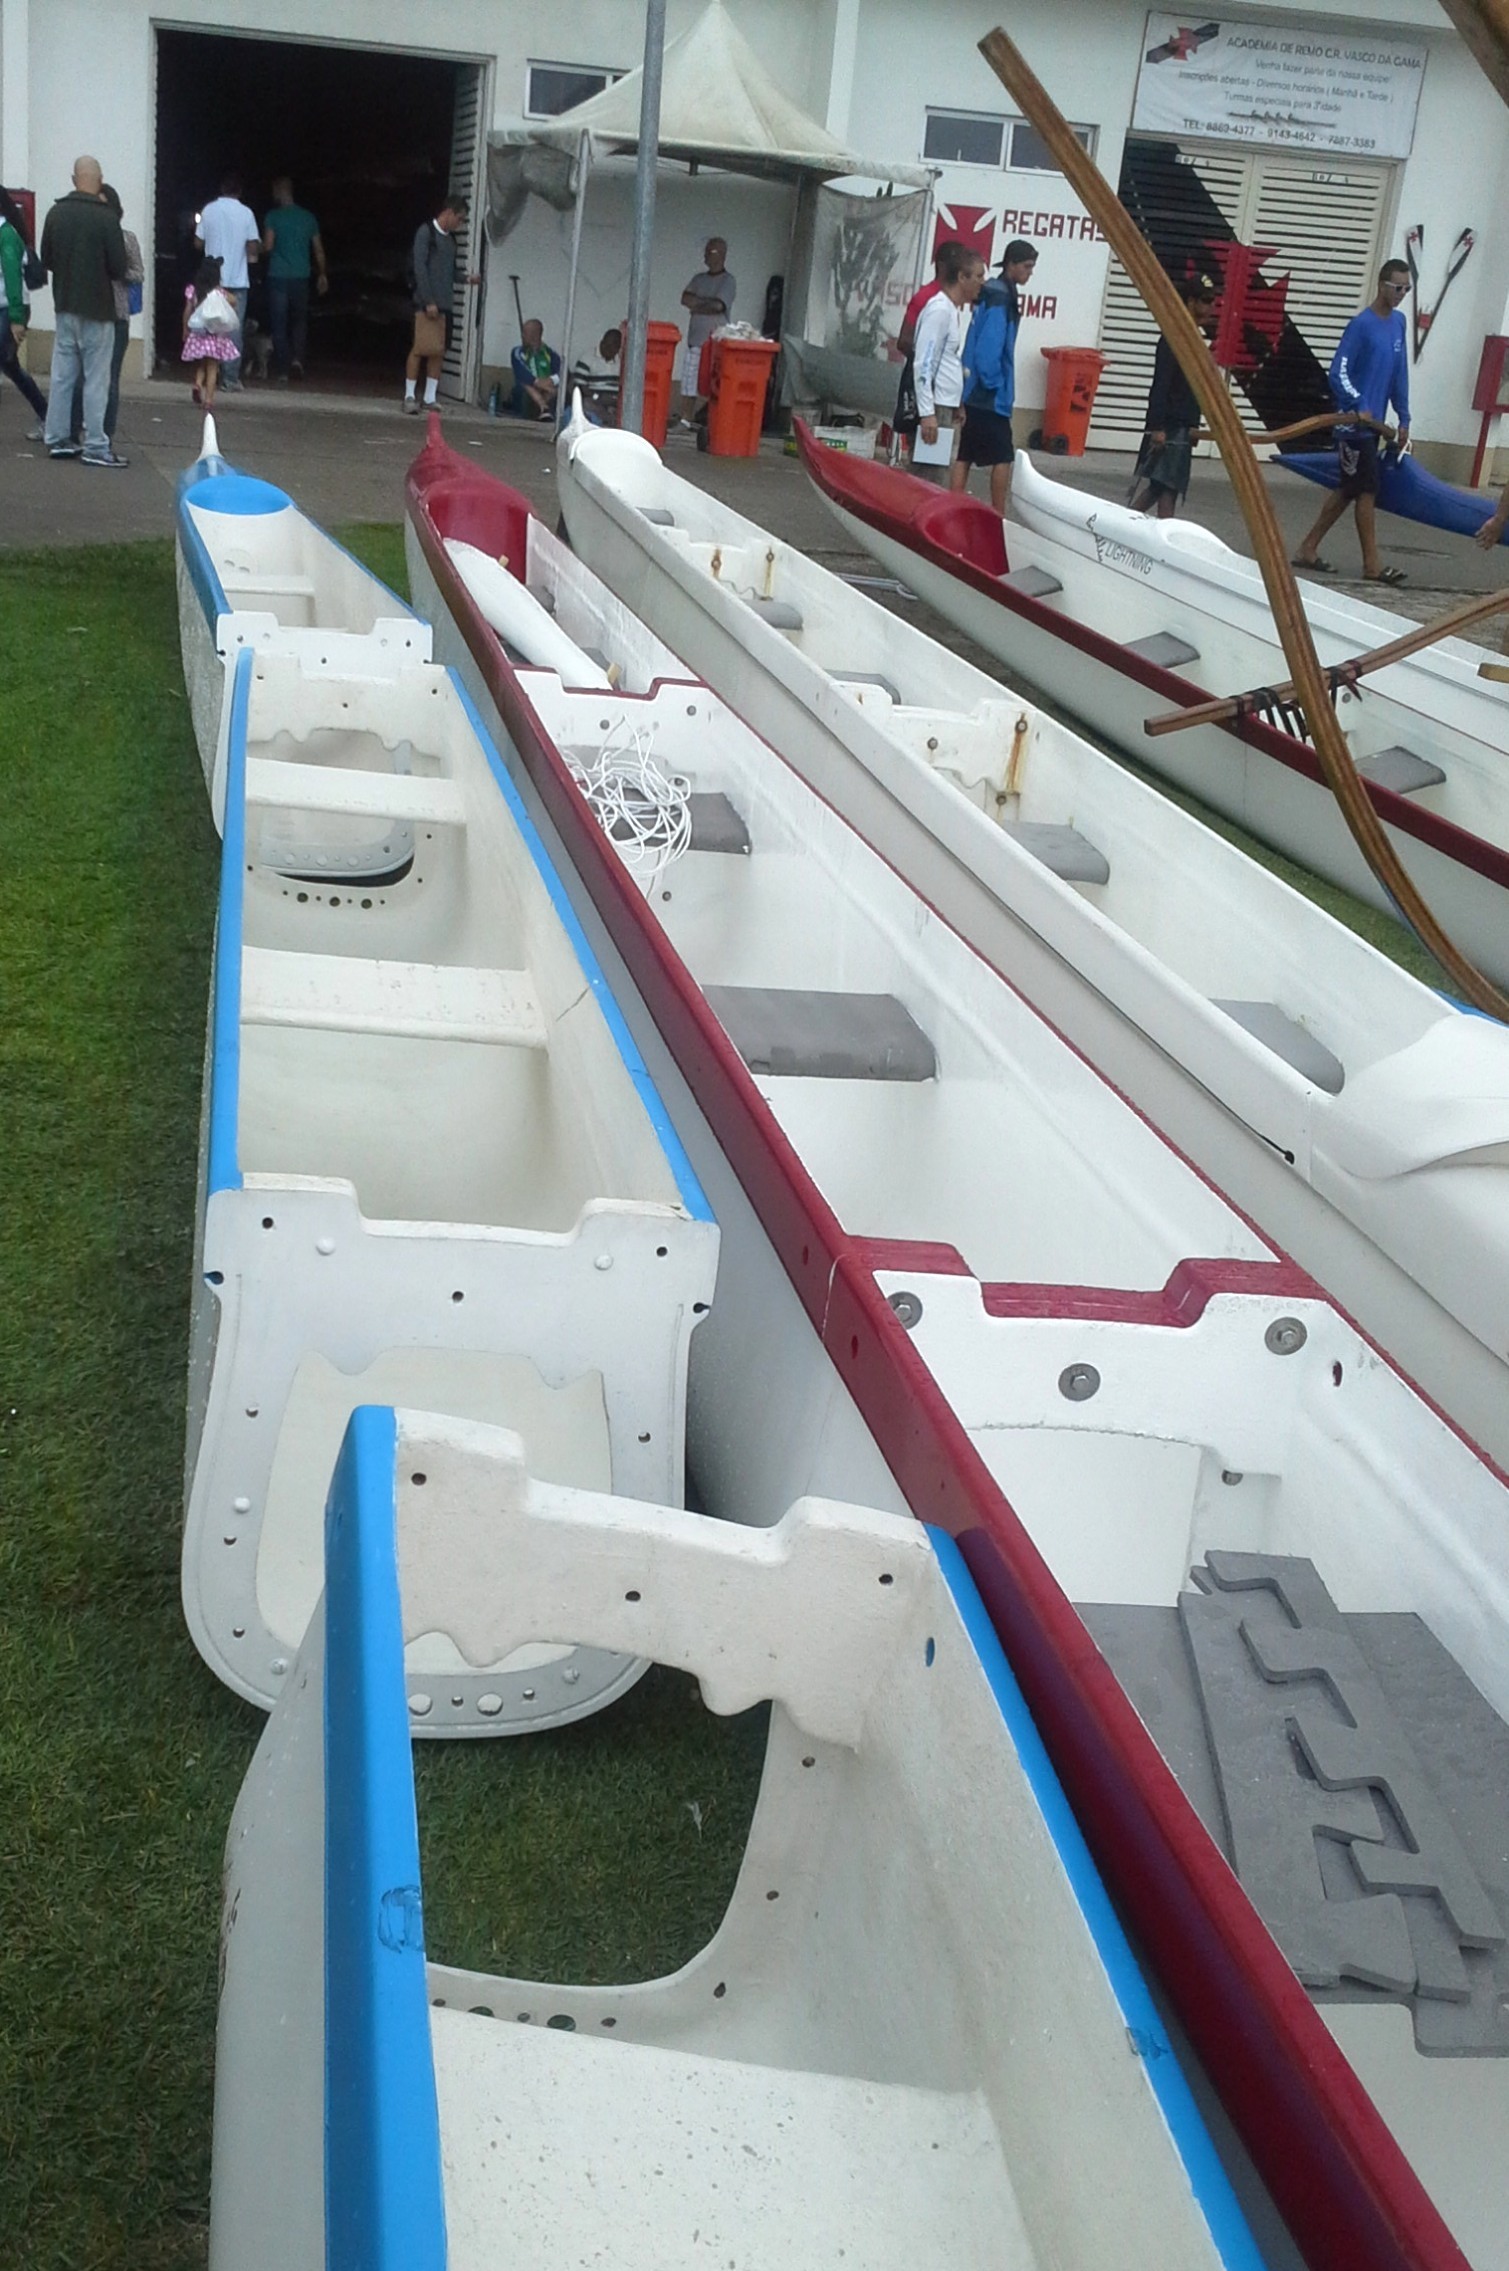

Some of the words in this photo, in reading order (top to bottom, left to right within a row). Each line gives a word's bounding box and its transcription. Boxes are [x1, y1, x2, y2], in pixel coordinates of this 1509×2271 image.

[1227, 37, 1278, 50] ACADEMIA
[1280, 43, 1292, 54] DE
[1295, 45, 1323, 57] REMO
[1344, 51, 1375, 62] VASCO
[1377, 54, 1391, 65] DA
[1393, 56, 1420, 69] GAMA
